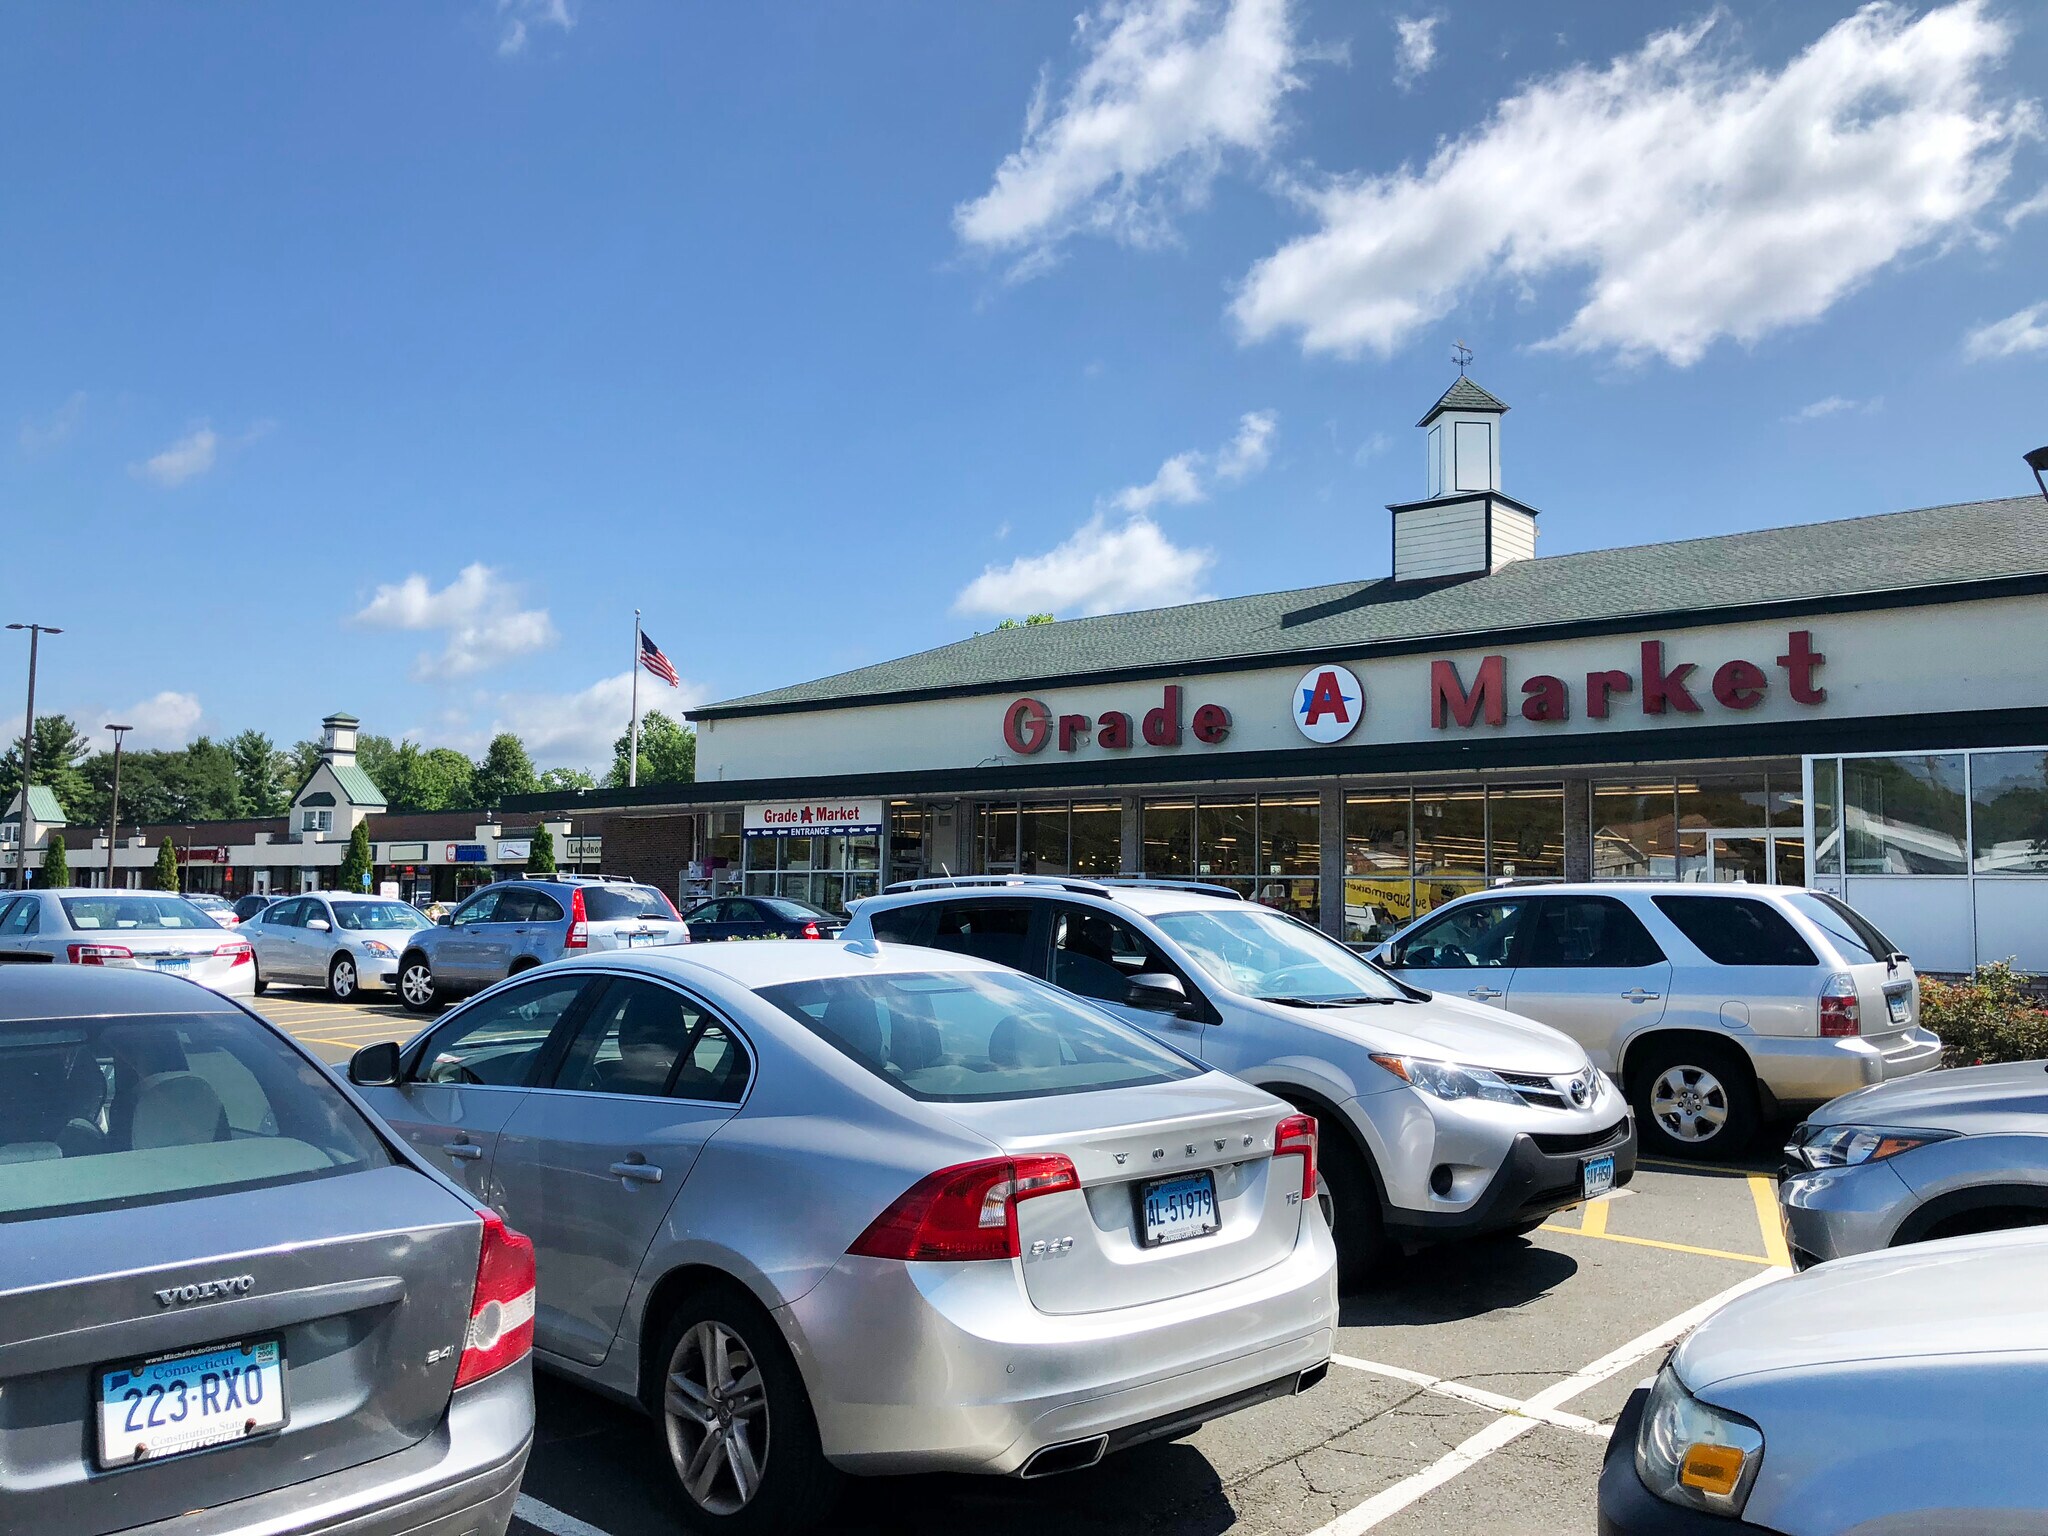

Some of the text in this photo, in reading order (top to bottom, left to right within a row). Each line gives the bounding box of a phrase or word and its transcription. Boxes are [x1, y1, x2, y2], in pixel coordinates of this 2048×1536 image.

[1003, 630, 1828, 754] Grade A Market
[764, 806, 860, 824] Grade A Market
[790, 827, 830, 836] ENTRANCE
[1112, 1133, 1254, 1165] VOLVO
[154, 1274, 255, 1304] VOLVO
[145, 1341, 242, 1365] www.MitchellAutoGroup.com
[153, 1355, 235, 1380] Connecticut
[151, 1420, 244, 1447] Constitution State
[180, 1429, 248, 1451] MITCHELL
